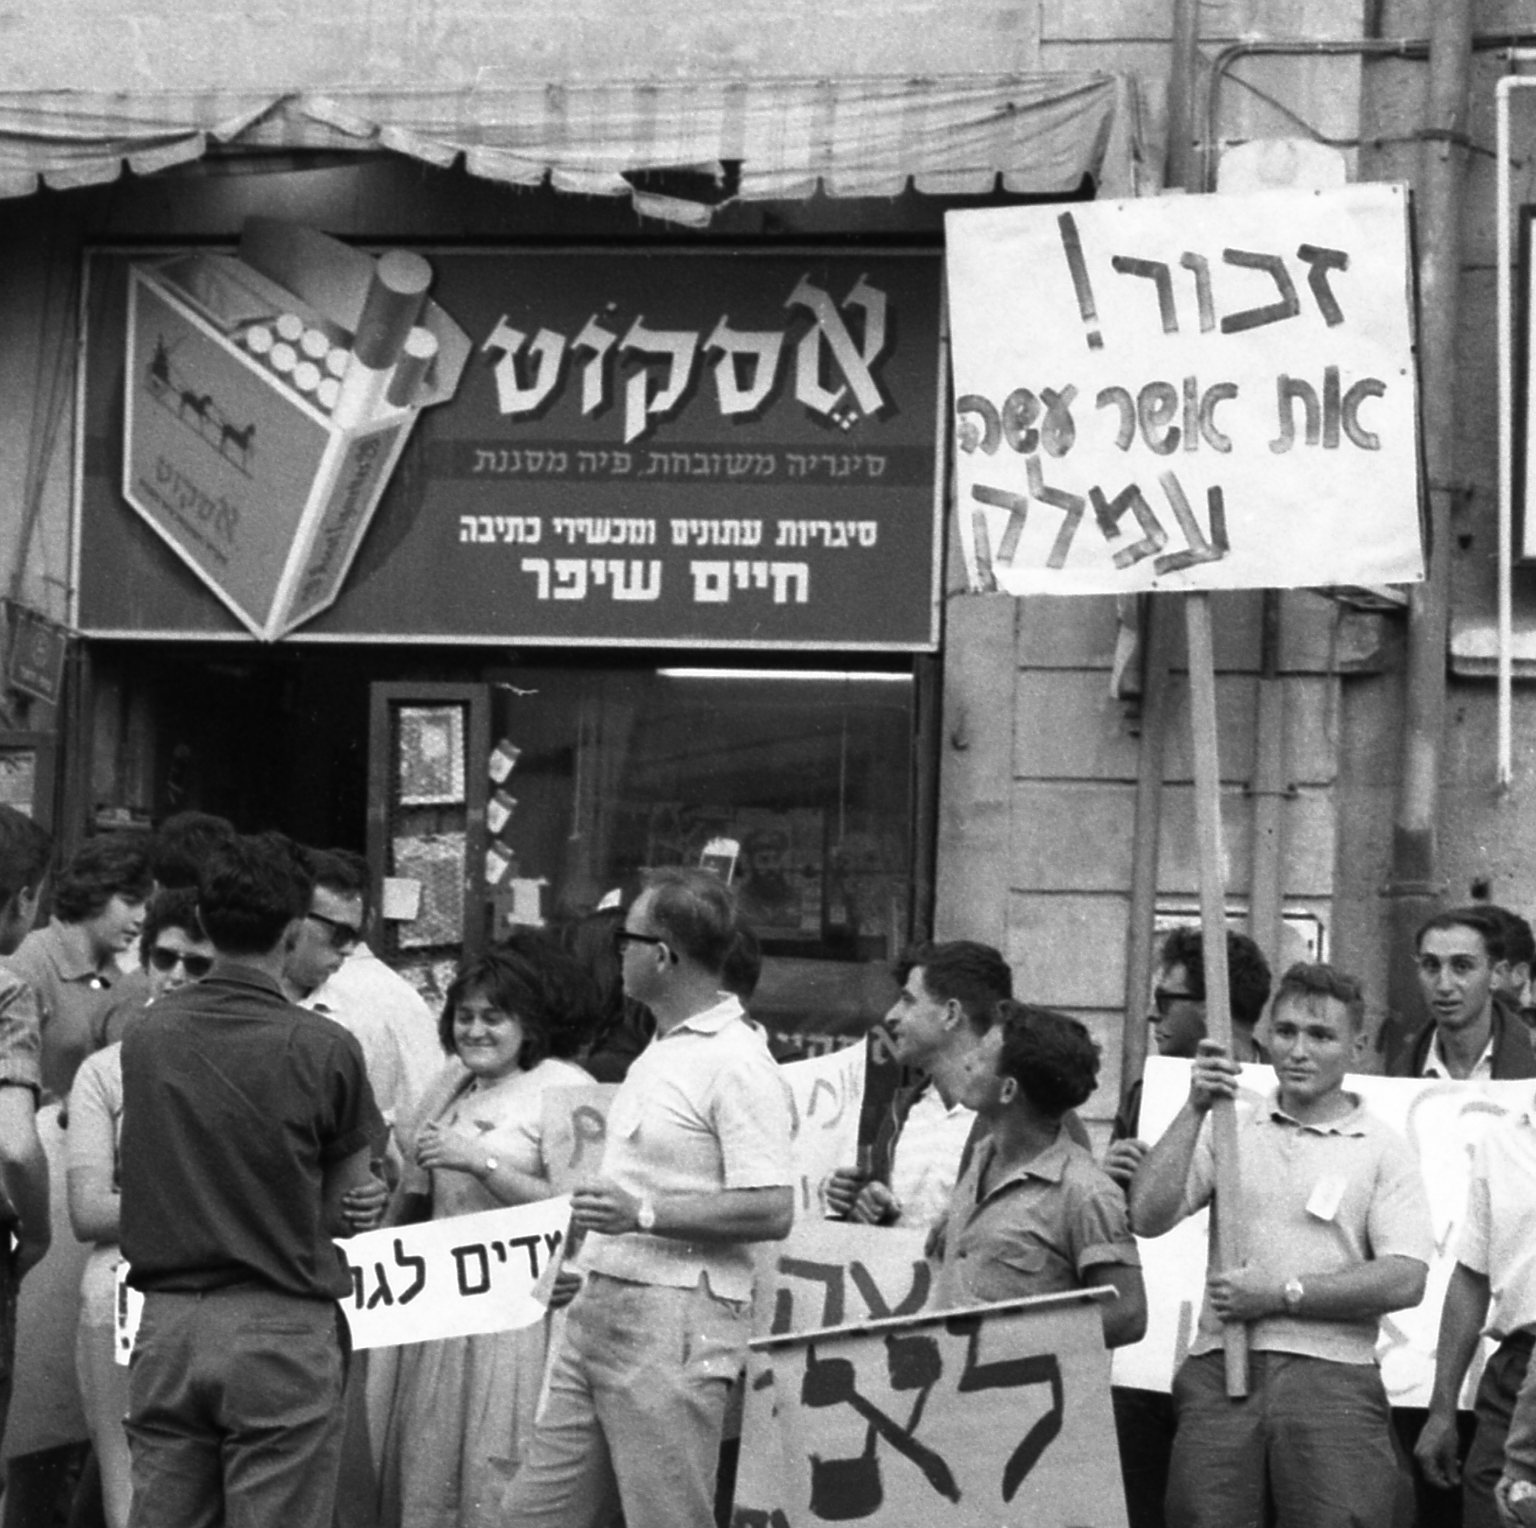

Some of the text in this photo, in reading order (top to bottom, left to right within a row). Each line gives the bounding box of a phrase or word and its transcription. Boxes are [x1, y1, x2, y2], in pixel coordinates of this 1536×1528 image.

[1058, 212, 1349, 349] זכור!
[957, 365, 1387, 457] את אשר עשה
[473, 448, 568, 473] מסננת
[577, 449, 632, 474] פיה
[785, 452, 886, 478] סיגריה
[460, 514, 877, 548] סיגריות עתונים ומכשירי כתיבה
[972, 455, 1230, 592] עמלק
[521, 558, 809, 604] חיים שיפר
[800, 1316, 1064, 1522] לא
